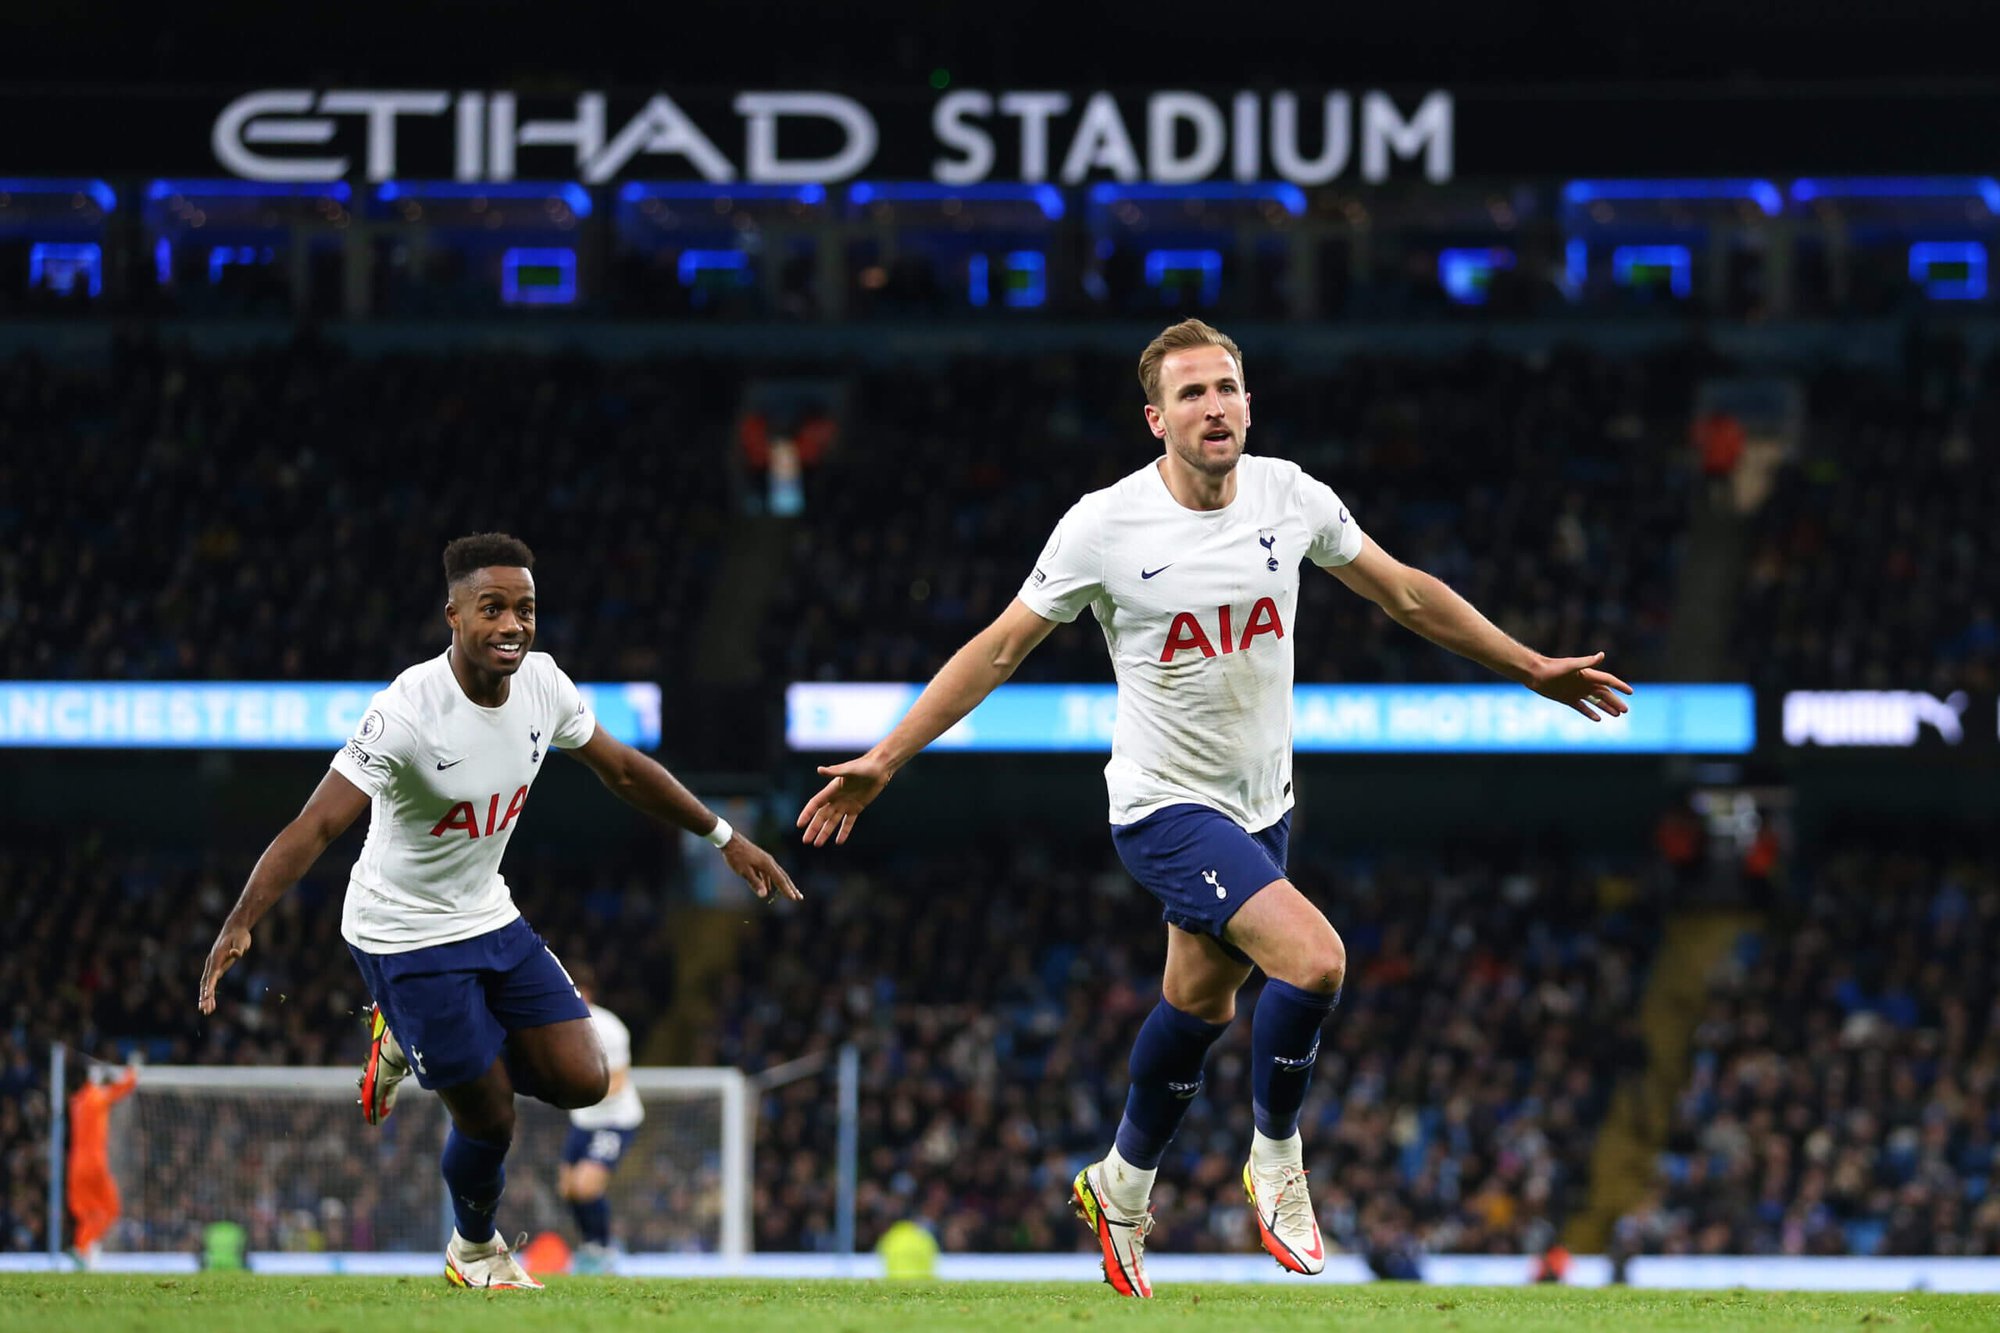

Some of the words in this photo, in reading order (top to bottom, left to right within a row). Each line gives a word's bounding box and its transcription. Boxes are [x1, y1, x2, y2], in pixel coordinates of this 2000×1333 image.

[211, 90, 878, 184] ETIHAD
[932, 90, 1455, 185] STADIUM
[1160, 596, 1285, 662] AIA
[0, 689, 309, 742] NCHESTER
[430, 784, 528, 839] AIA
